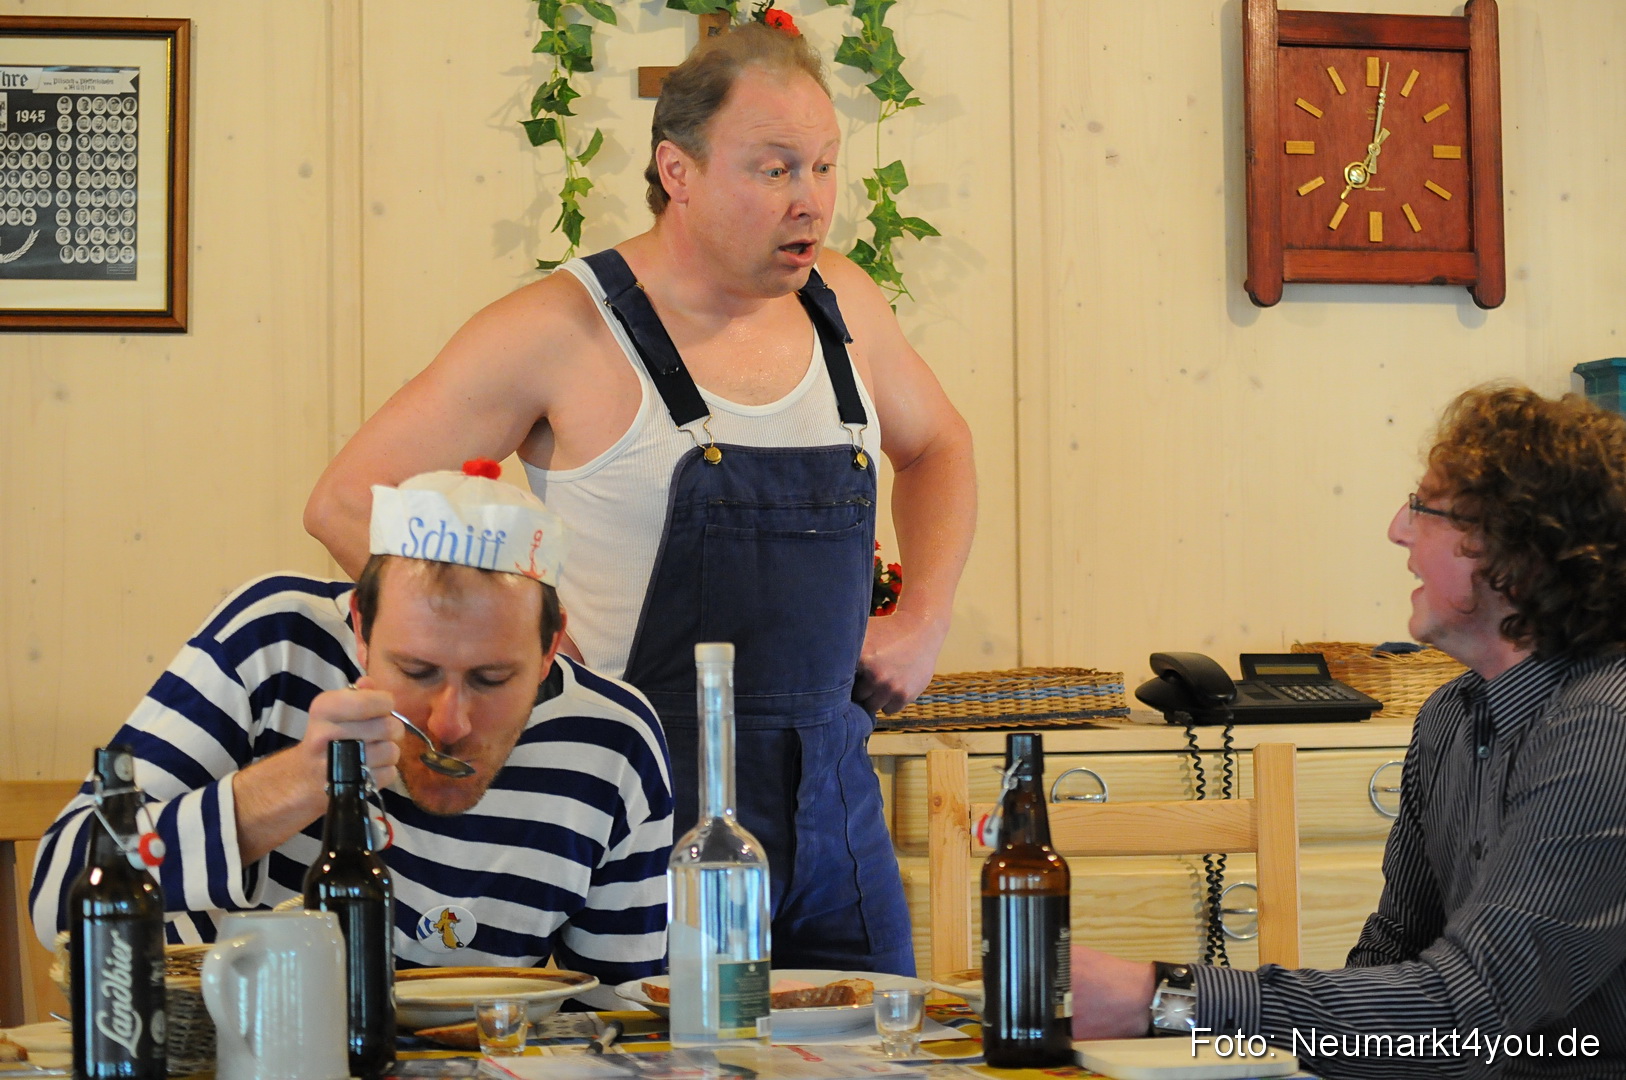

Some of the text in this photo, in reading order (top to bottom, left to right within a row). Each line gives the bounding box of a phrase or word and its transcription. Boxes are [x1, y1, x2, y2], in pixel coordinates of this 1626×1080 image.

[0, 70, 28, 88] hre
[16, 109, 46, 123] 1945
[401, 516, 506, 570] Schiff
[95, 929, 143, 1059] Landbier
